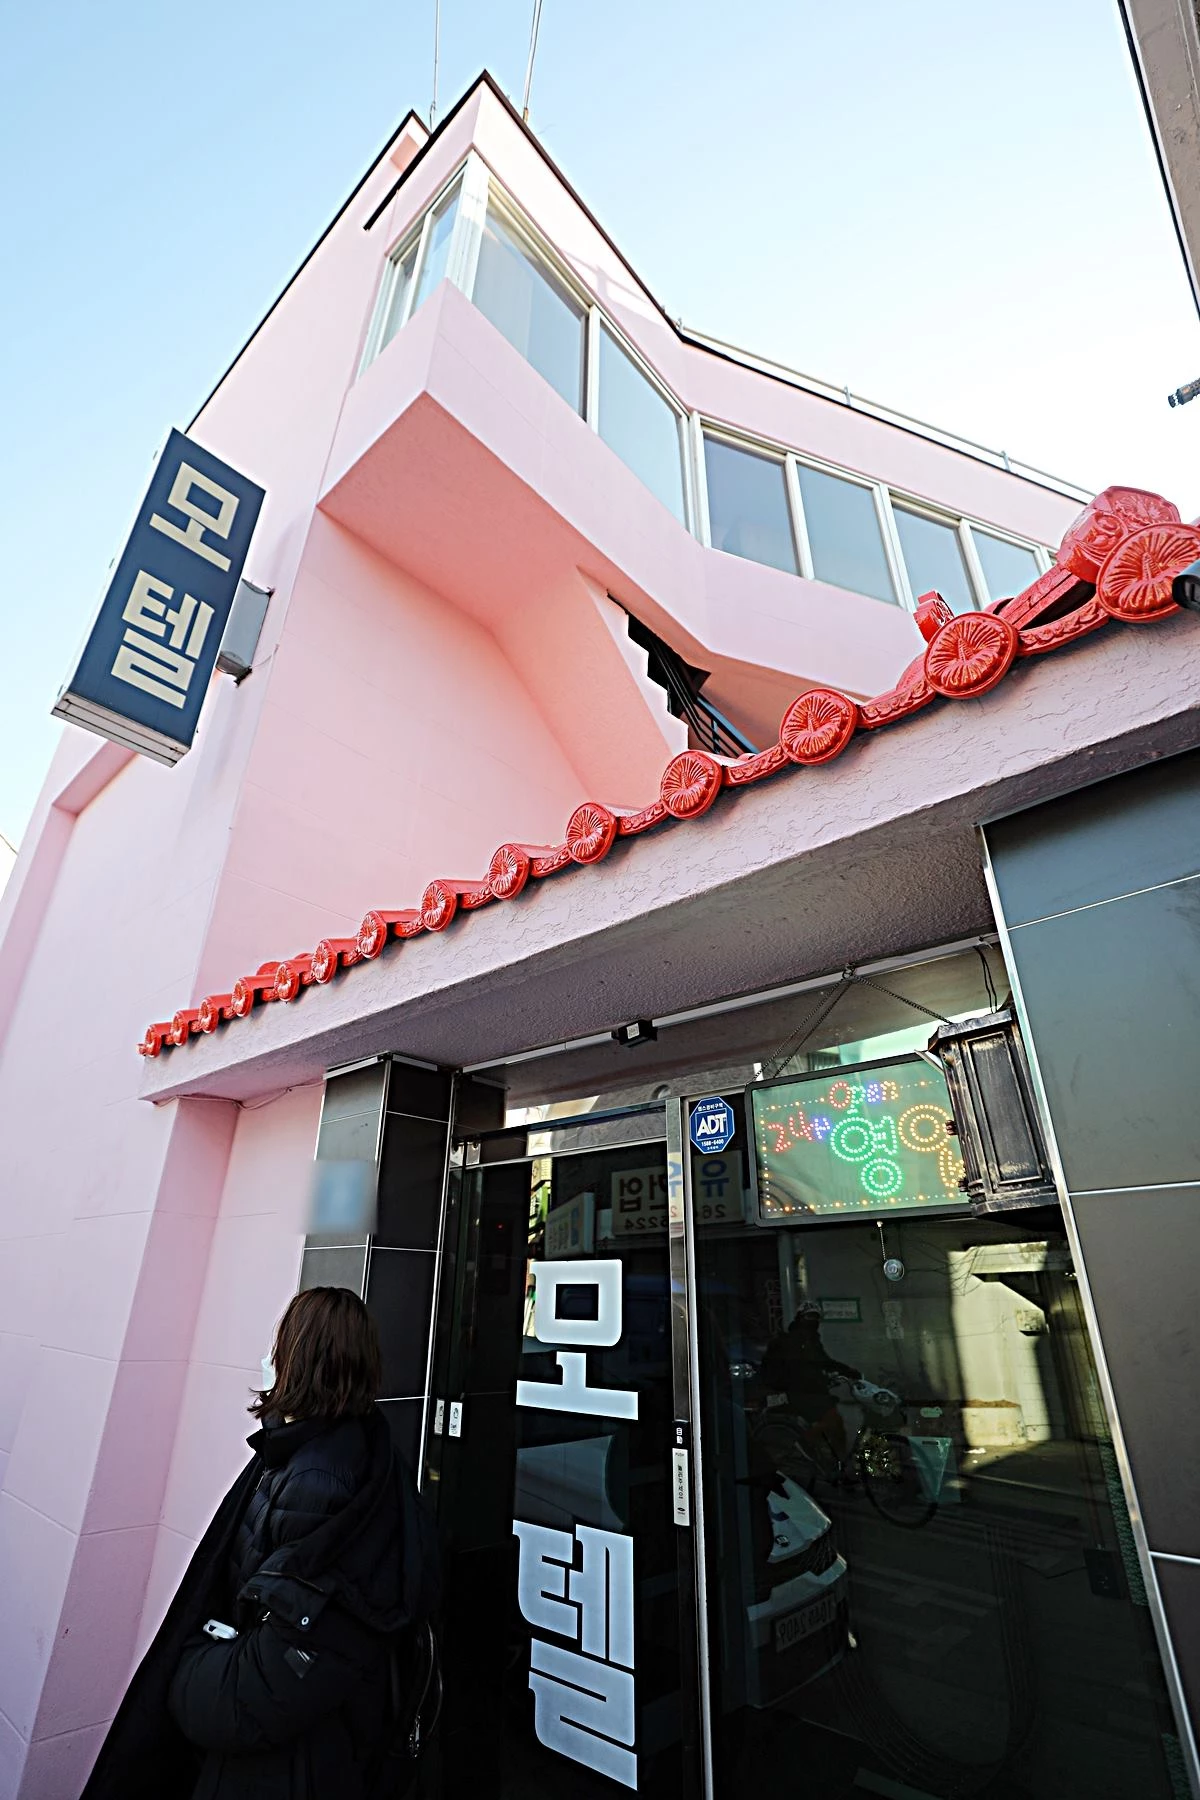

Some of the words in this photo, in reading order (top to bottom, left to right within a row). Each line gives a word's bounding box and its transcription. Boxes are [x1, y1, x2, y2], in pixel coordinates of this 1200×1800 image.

[110, 461, 241, 710] 모텔
[697, 1113, 727, 1137] ADT
[828, 1081, 899, 1115] Open
[513, 1259, 639, 1790] 모텔
